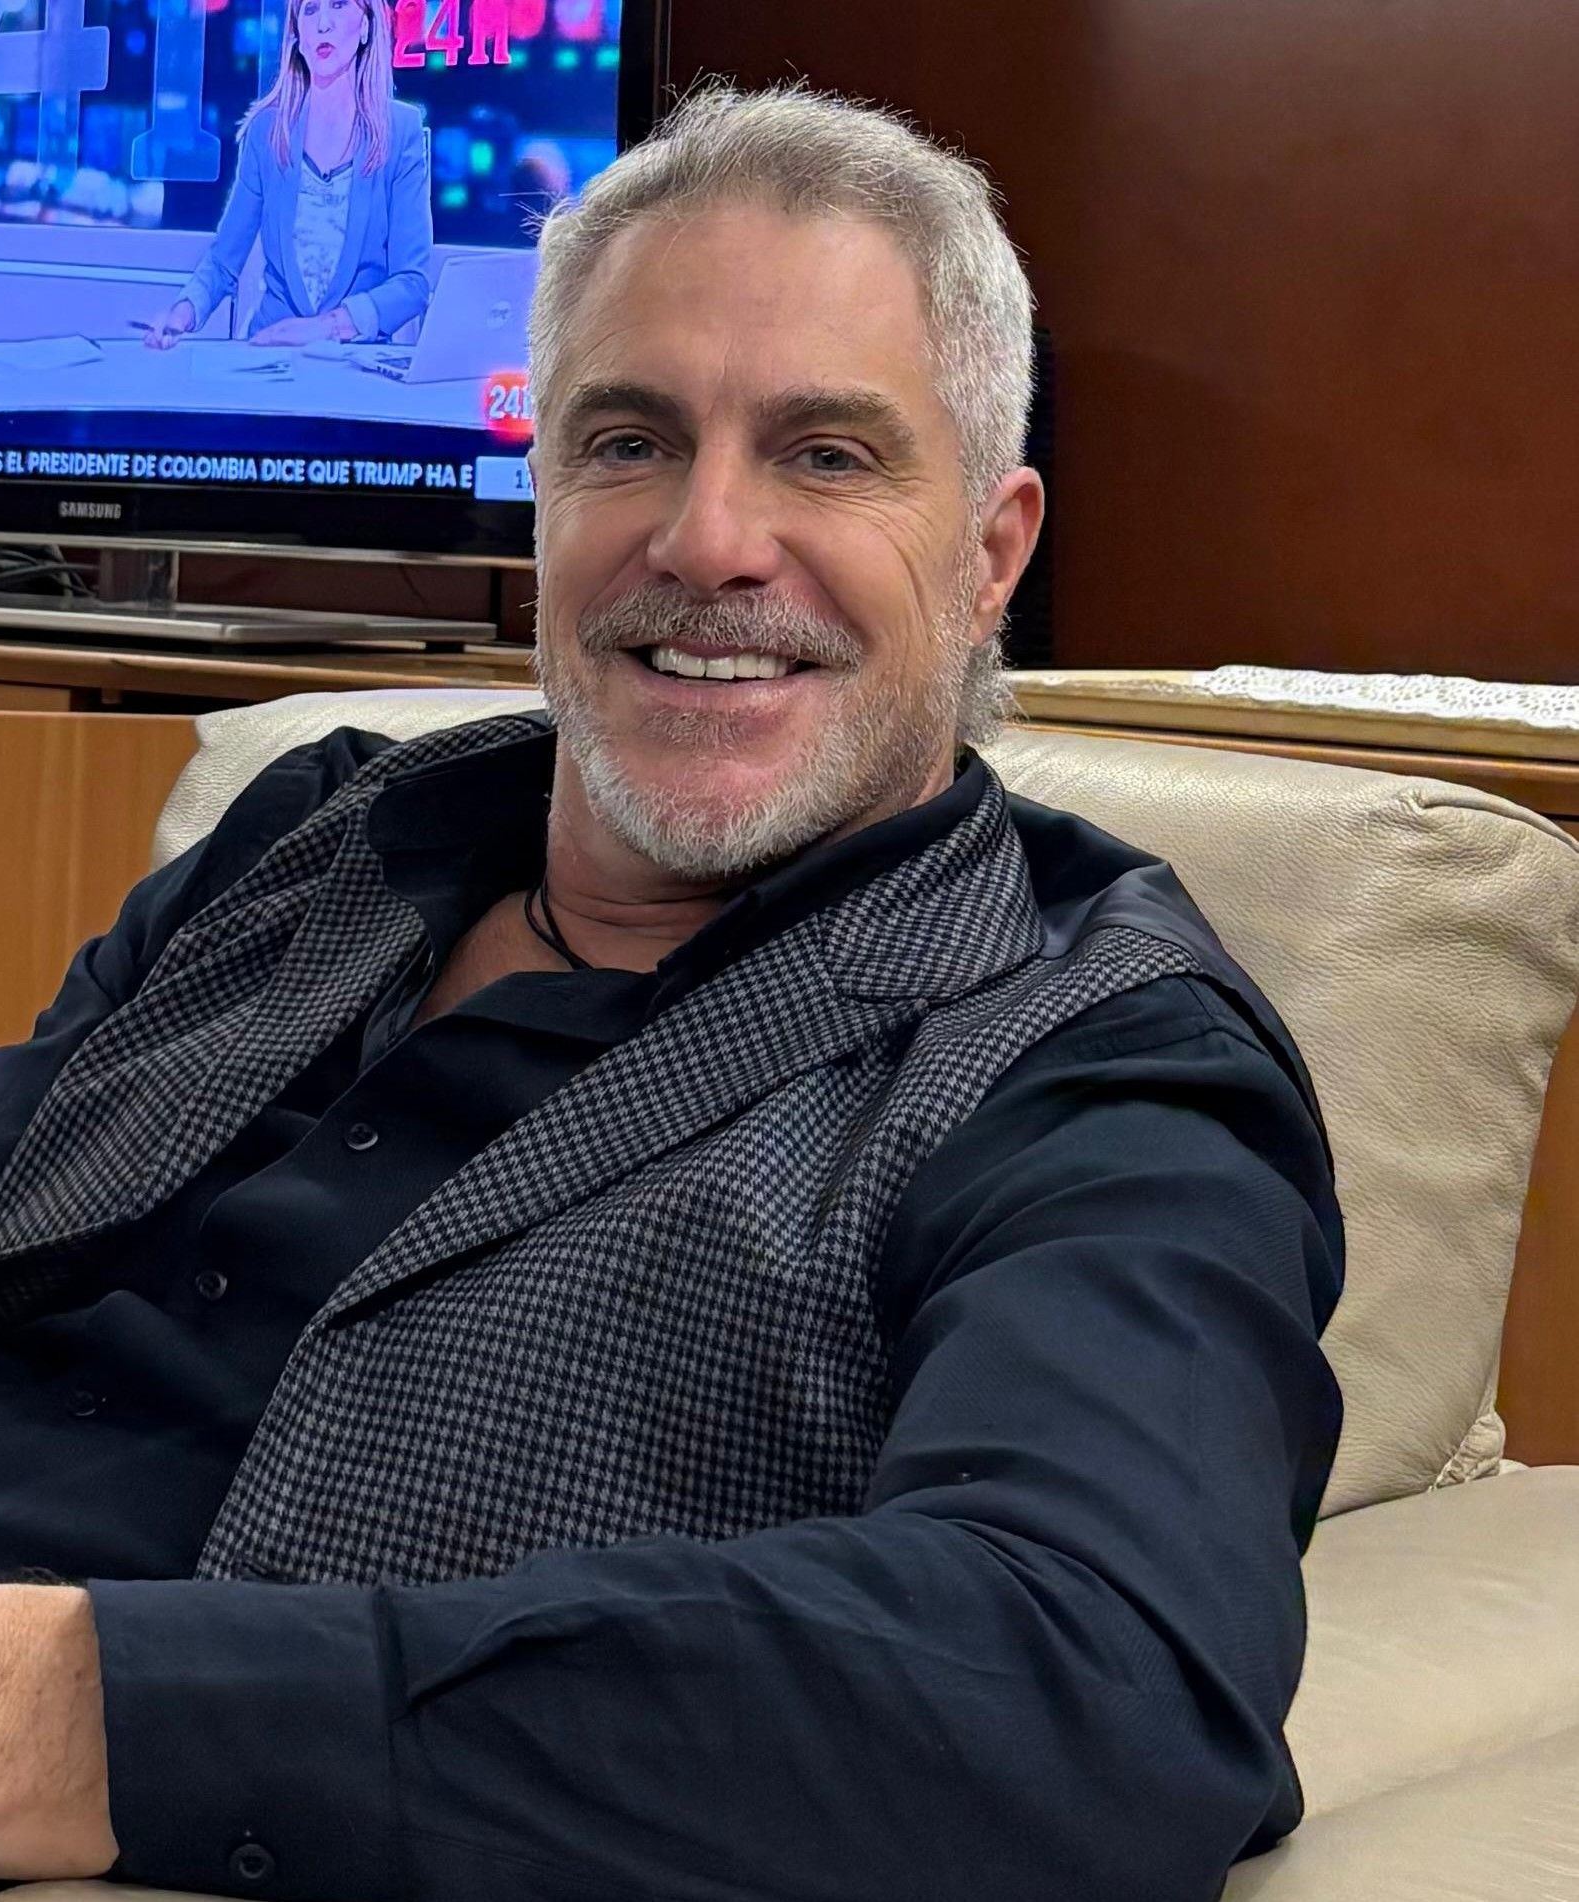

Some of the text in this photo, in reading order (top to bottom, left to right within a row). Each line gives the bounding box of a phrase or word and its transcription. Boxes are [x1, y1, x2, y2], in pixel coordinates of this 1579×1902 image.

[5, 450, 24, 473] EL
[26, 451, 130, 477] PRESIDENTE
[131, 454, 157, 478] DE
[158, 454, 257, 481] COLOMBIA
[260, 458, 306, 482] DICE
[307, 459, 350, 484] QUE
[353, 461, 423, 486] TRUMP
[425, 463, 457, 488] HA
[59, 501, 122, 519] SAMSUNG
